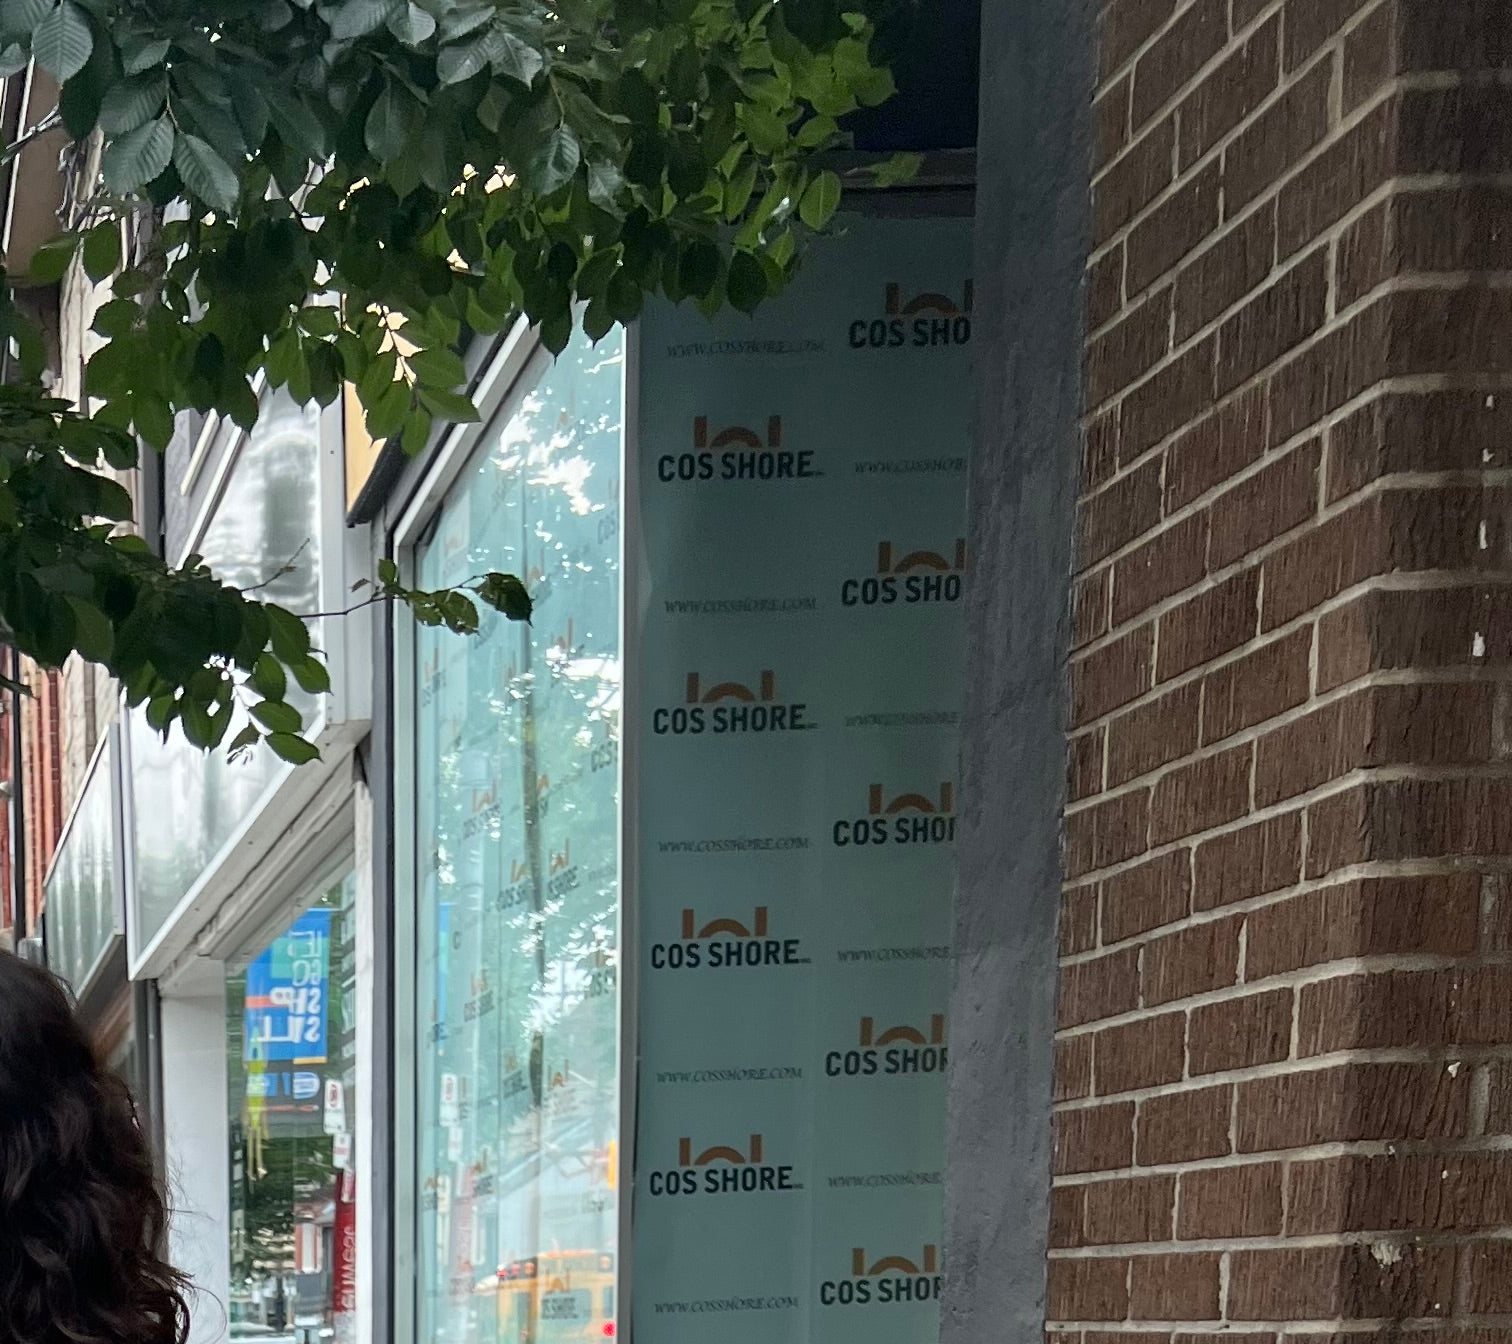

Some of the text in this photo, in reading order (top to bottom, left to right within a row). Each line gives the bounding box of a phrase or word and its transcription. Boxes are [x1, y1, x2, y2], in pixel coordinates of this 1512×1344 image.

[849, 319, 904, 348] COS
[659, 451, 813, 481] COS SHORE
[842, 577, 897, 605] COS
[654, 704, 806, 734] COS SHORE
[834, 819, 887, 846] COS
[652, 940, 799, 968] COS SHORE
[826, 1050, 877, 1076] COS
[650, 1166, 793, 1195] COS SHORE
[821, 1280, 870, 1305] COS
